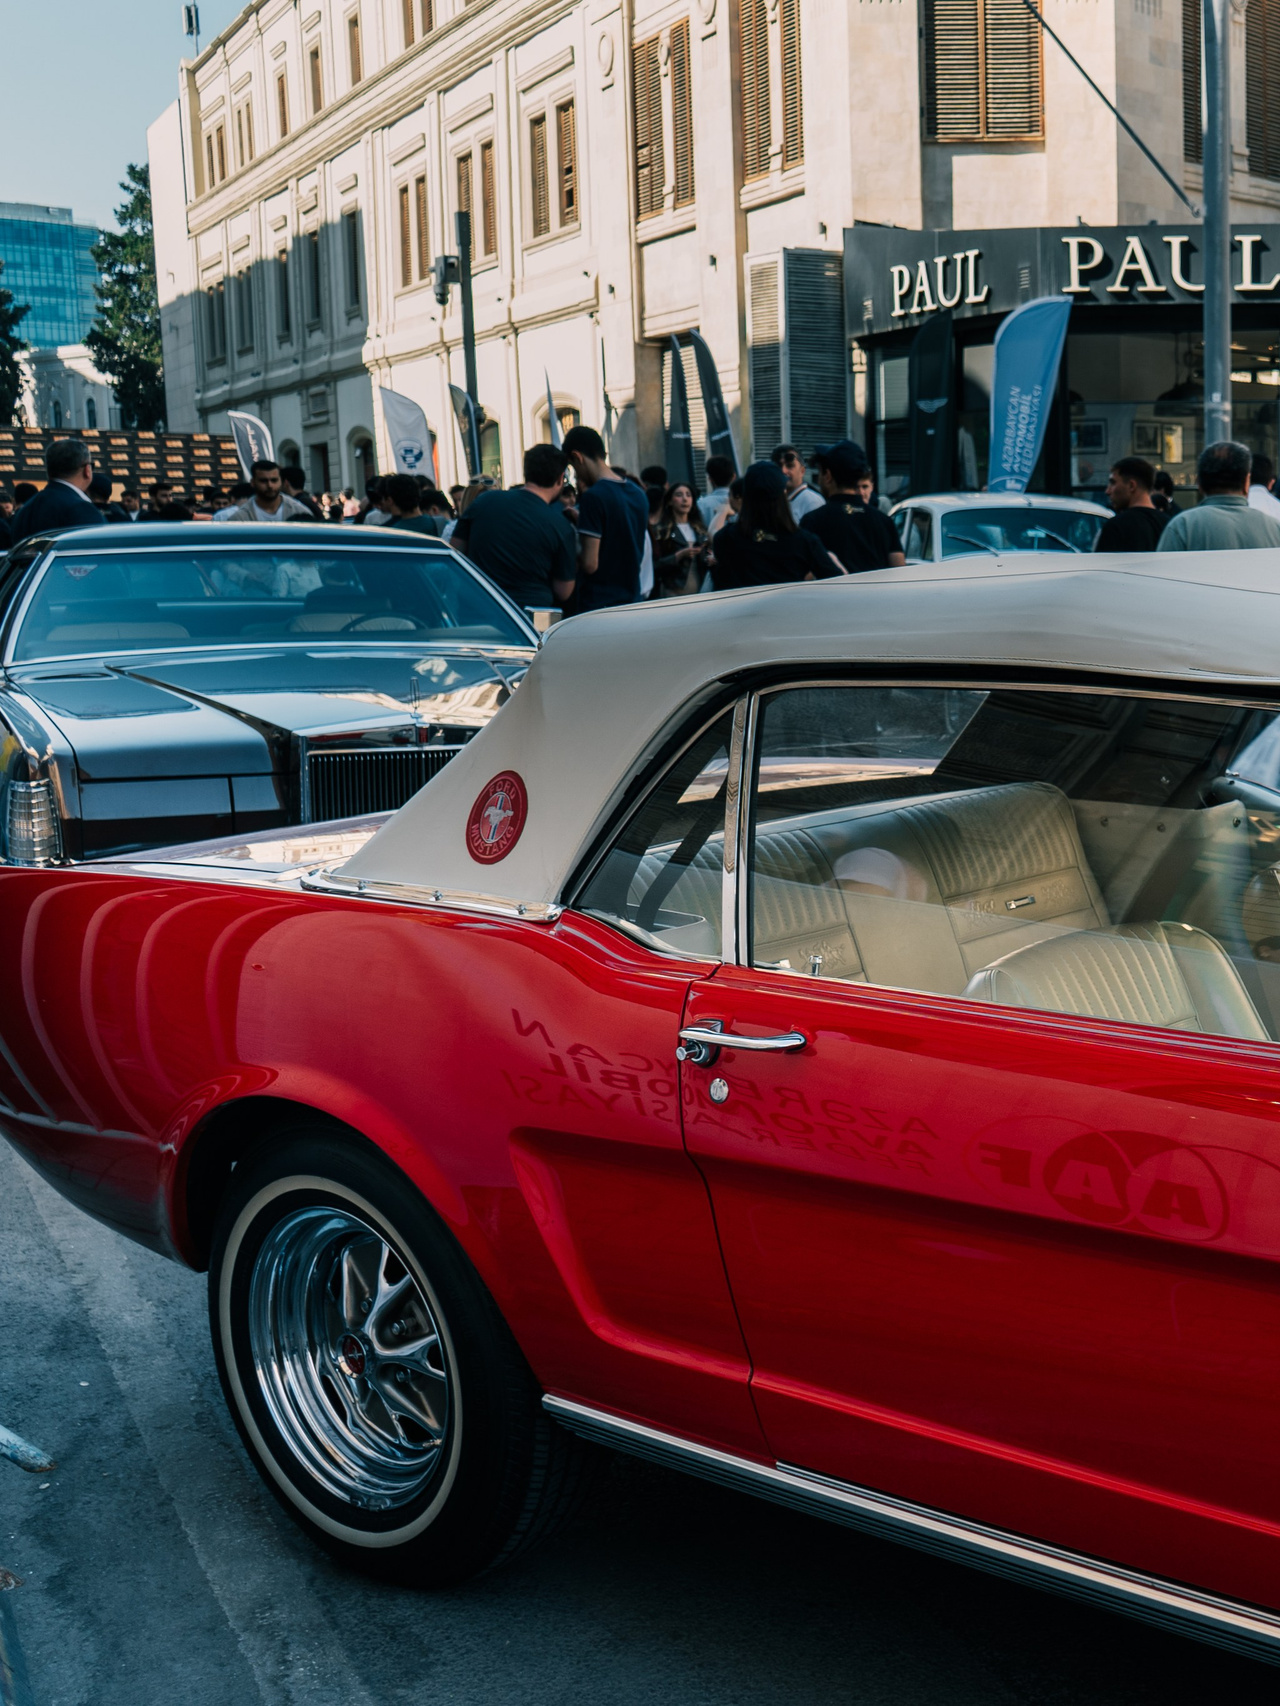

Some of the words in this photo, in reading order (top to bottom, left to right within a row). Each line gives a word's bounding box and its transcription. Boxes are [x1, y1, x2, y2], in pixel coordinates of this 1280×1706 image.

[890, 249, 989, 317] PAUL
[489, 781, 517, 800] FORD
[471, 823, 514, 855] MUSTANG
